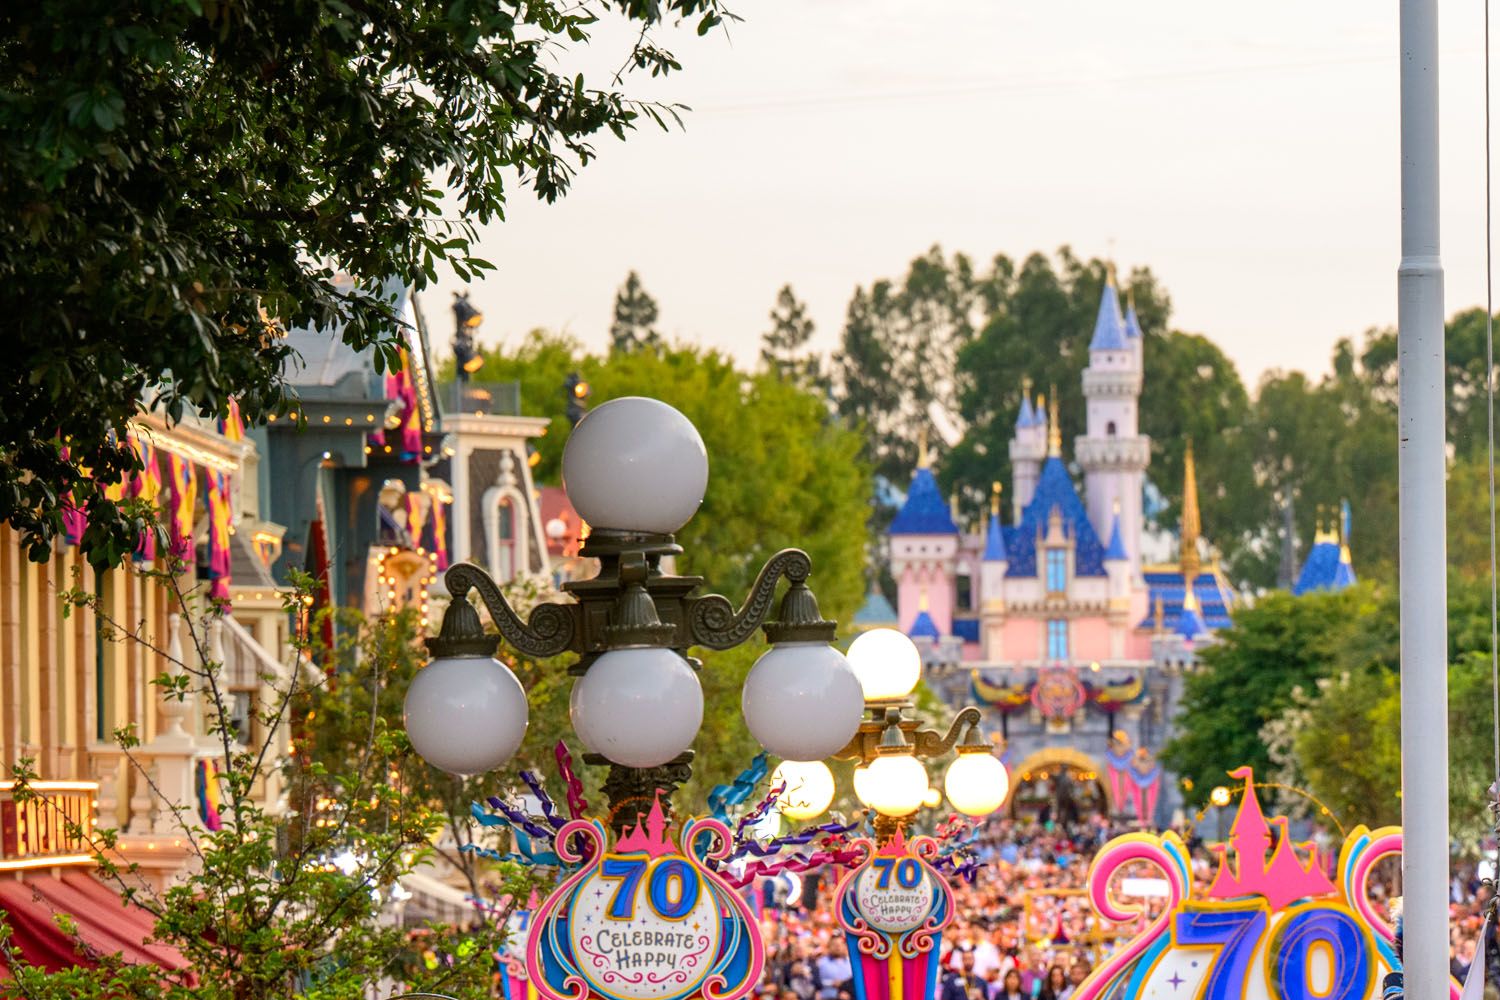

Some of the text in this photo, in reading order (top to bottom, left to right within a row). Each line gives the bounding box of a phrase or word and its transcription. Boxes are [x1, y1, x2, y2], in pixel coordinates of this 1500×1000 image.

[872, 856, 923, 890] 70
[600, 853, 702, 922] 70
[870, 895, 920, 908] CELEBRATE
[881, 904, 912, 915] HAPPY
[596, 929, 694, 954] CELEBRATE
[616, 949, 677, 970] HAPPY
